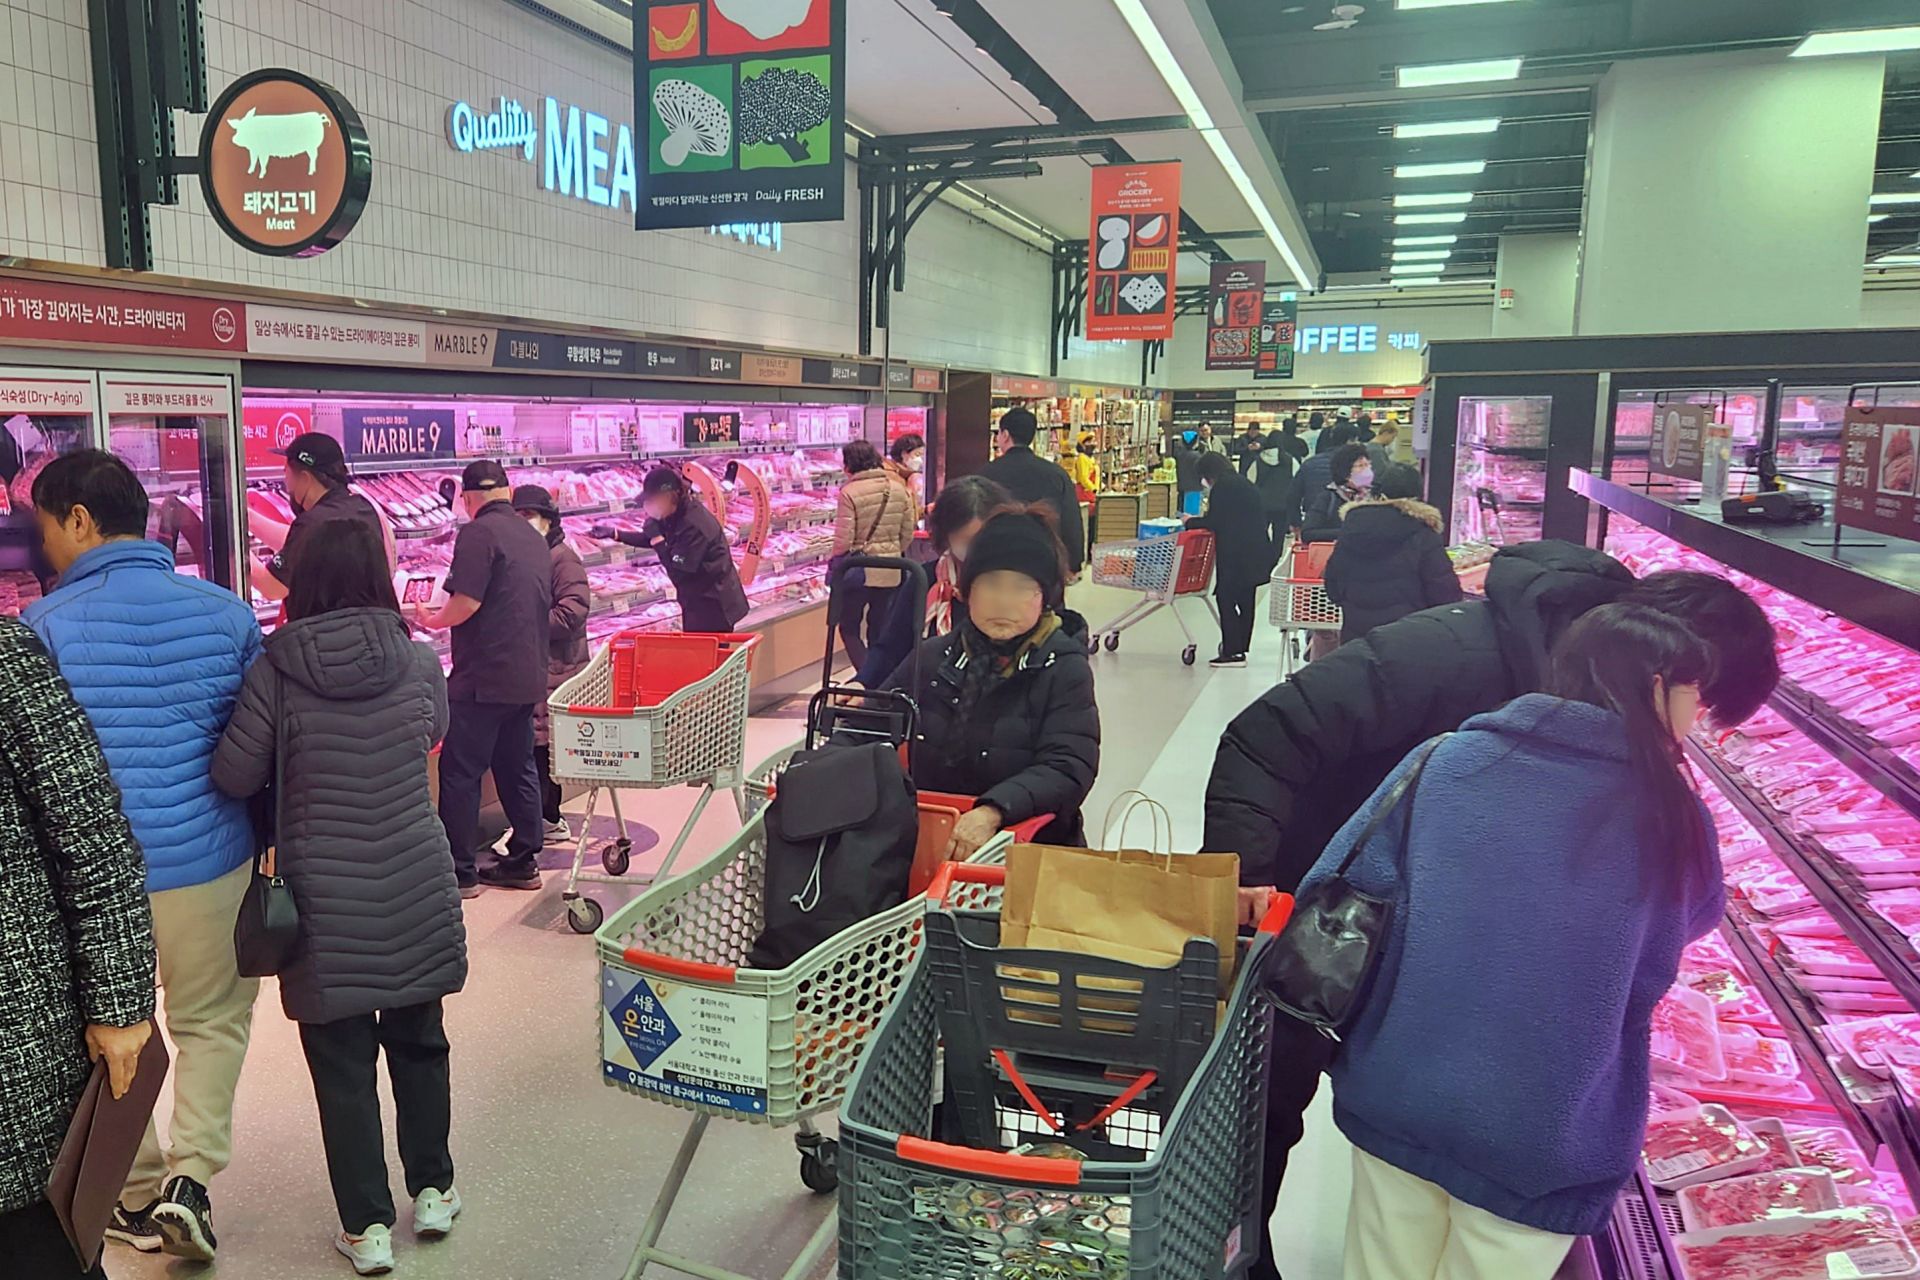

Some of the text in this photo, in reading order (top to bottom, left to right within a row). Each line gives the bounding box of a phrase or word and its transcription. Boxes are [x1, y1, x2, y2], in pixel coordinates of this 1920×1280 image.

[453, 97, 536, 161] Quality
[651, 188, 824, 206] 계절마다 달라지는 신선한 감각 Daily FRESH
[1118, 188, 1152, 196] GROCERY
[243, 190, 316, 215] 돼지고기
[266, 217, 295, 230] Meat
[0, 297, 186, 331] 가 가장 깊어지는 시간, 드라이빈티지
[219, 315, 229, 326] Dry
[254, 319, 421, 349] 일상 속에서도 즐길 수 있는 드라이에이징의 깊은 풍미
[1388, 332, 1420, 350] 커피
[434, 333, 488, 355] MARBLE 9
[510, 340, 529, 360] 마블나인
[567, 346, 601, 363] 무항생제 한우
[647, 352, 658, 366] 한우
[125, 393, 213, 406] 깊은 풍미와 부드러움을 선사
[284, 424, 297, 440] Dry
[362, 421, 441, 454] MARBLE 9
[583, 758, 623, 767] 확인해보세요!
[633, 994, 654, 1013] 서울
[667, 1060, 763, 1085] 서울대학교 병원 출신 안과 전문의
[637, 1076, 731, 1106] 불광역 8번 출구에서 100m
[677, 1074, 703, 1087] 상담문의
[735, 1086, 756, 1096] 0112
